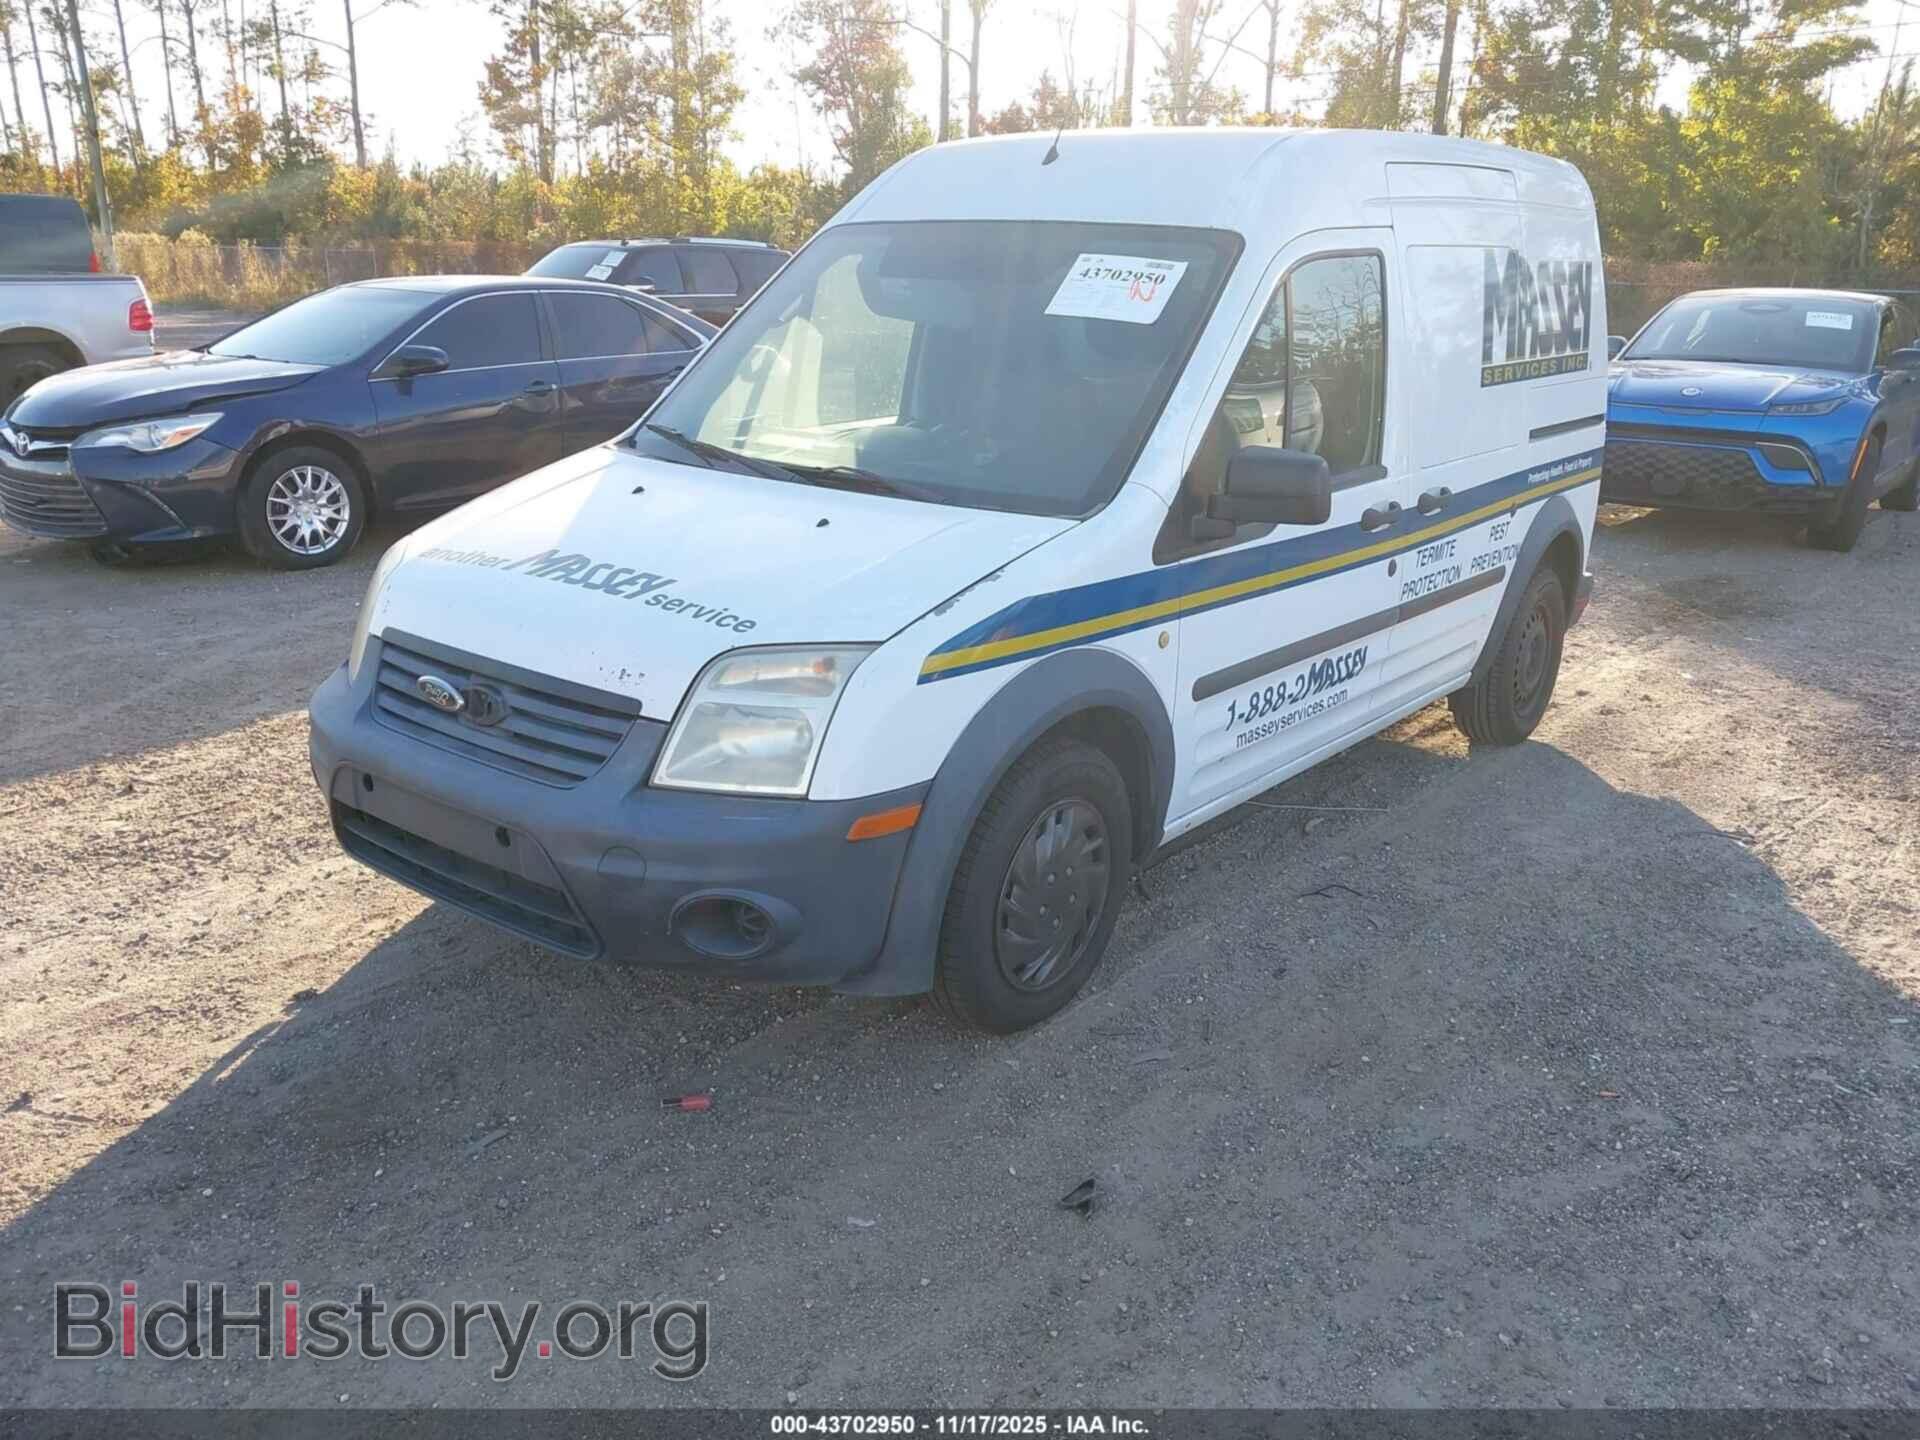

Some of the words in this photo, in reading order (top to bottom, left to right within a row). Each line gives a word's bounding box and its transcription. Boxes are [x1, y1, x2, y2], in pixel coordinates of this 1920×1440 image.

[1079, 267, 1167, 286] 43702950
[1482, 250, 1592, 365] MASSEY
[1483, 360, 1557, 384] SERVICES
[1488, 521, 1511, 543] PEST
[1415, 539, 1457, 568] TERMITE
[1470, 542, 1521, 574] PREVENTION
[418, 547, 512, 569] another
[503, 549, 677, 600] MASSEY
[645, 591, 757, 633] service
[1401, 563, 1463, 601] PROTECTION
[1236, 688, 1348, 748] masseyservices.com
